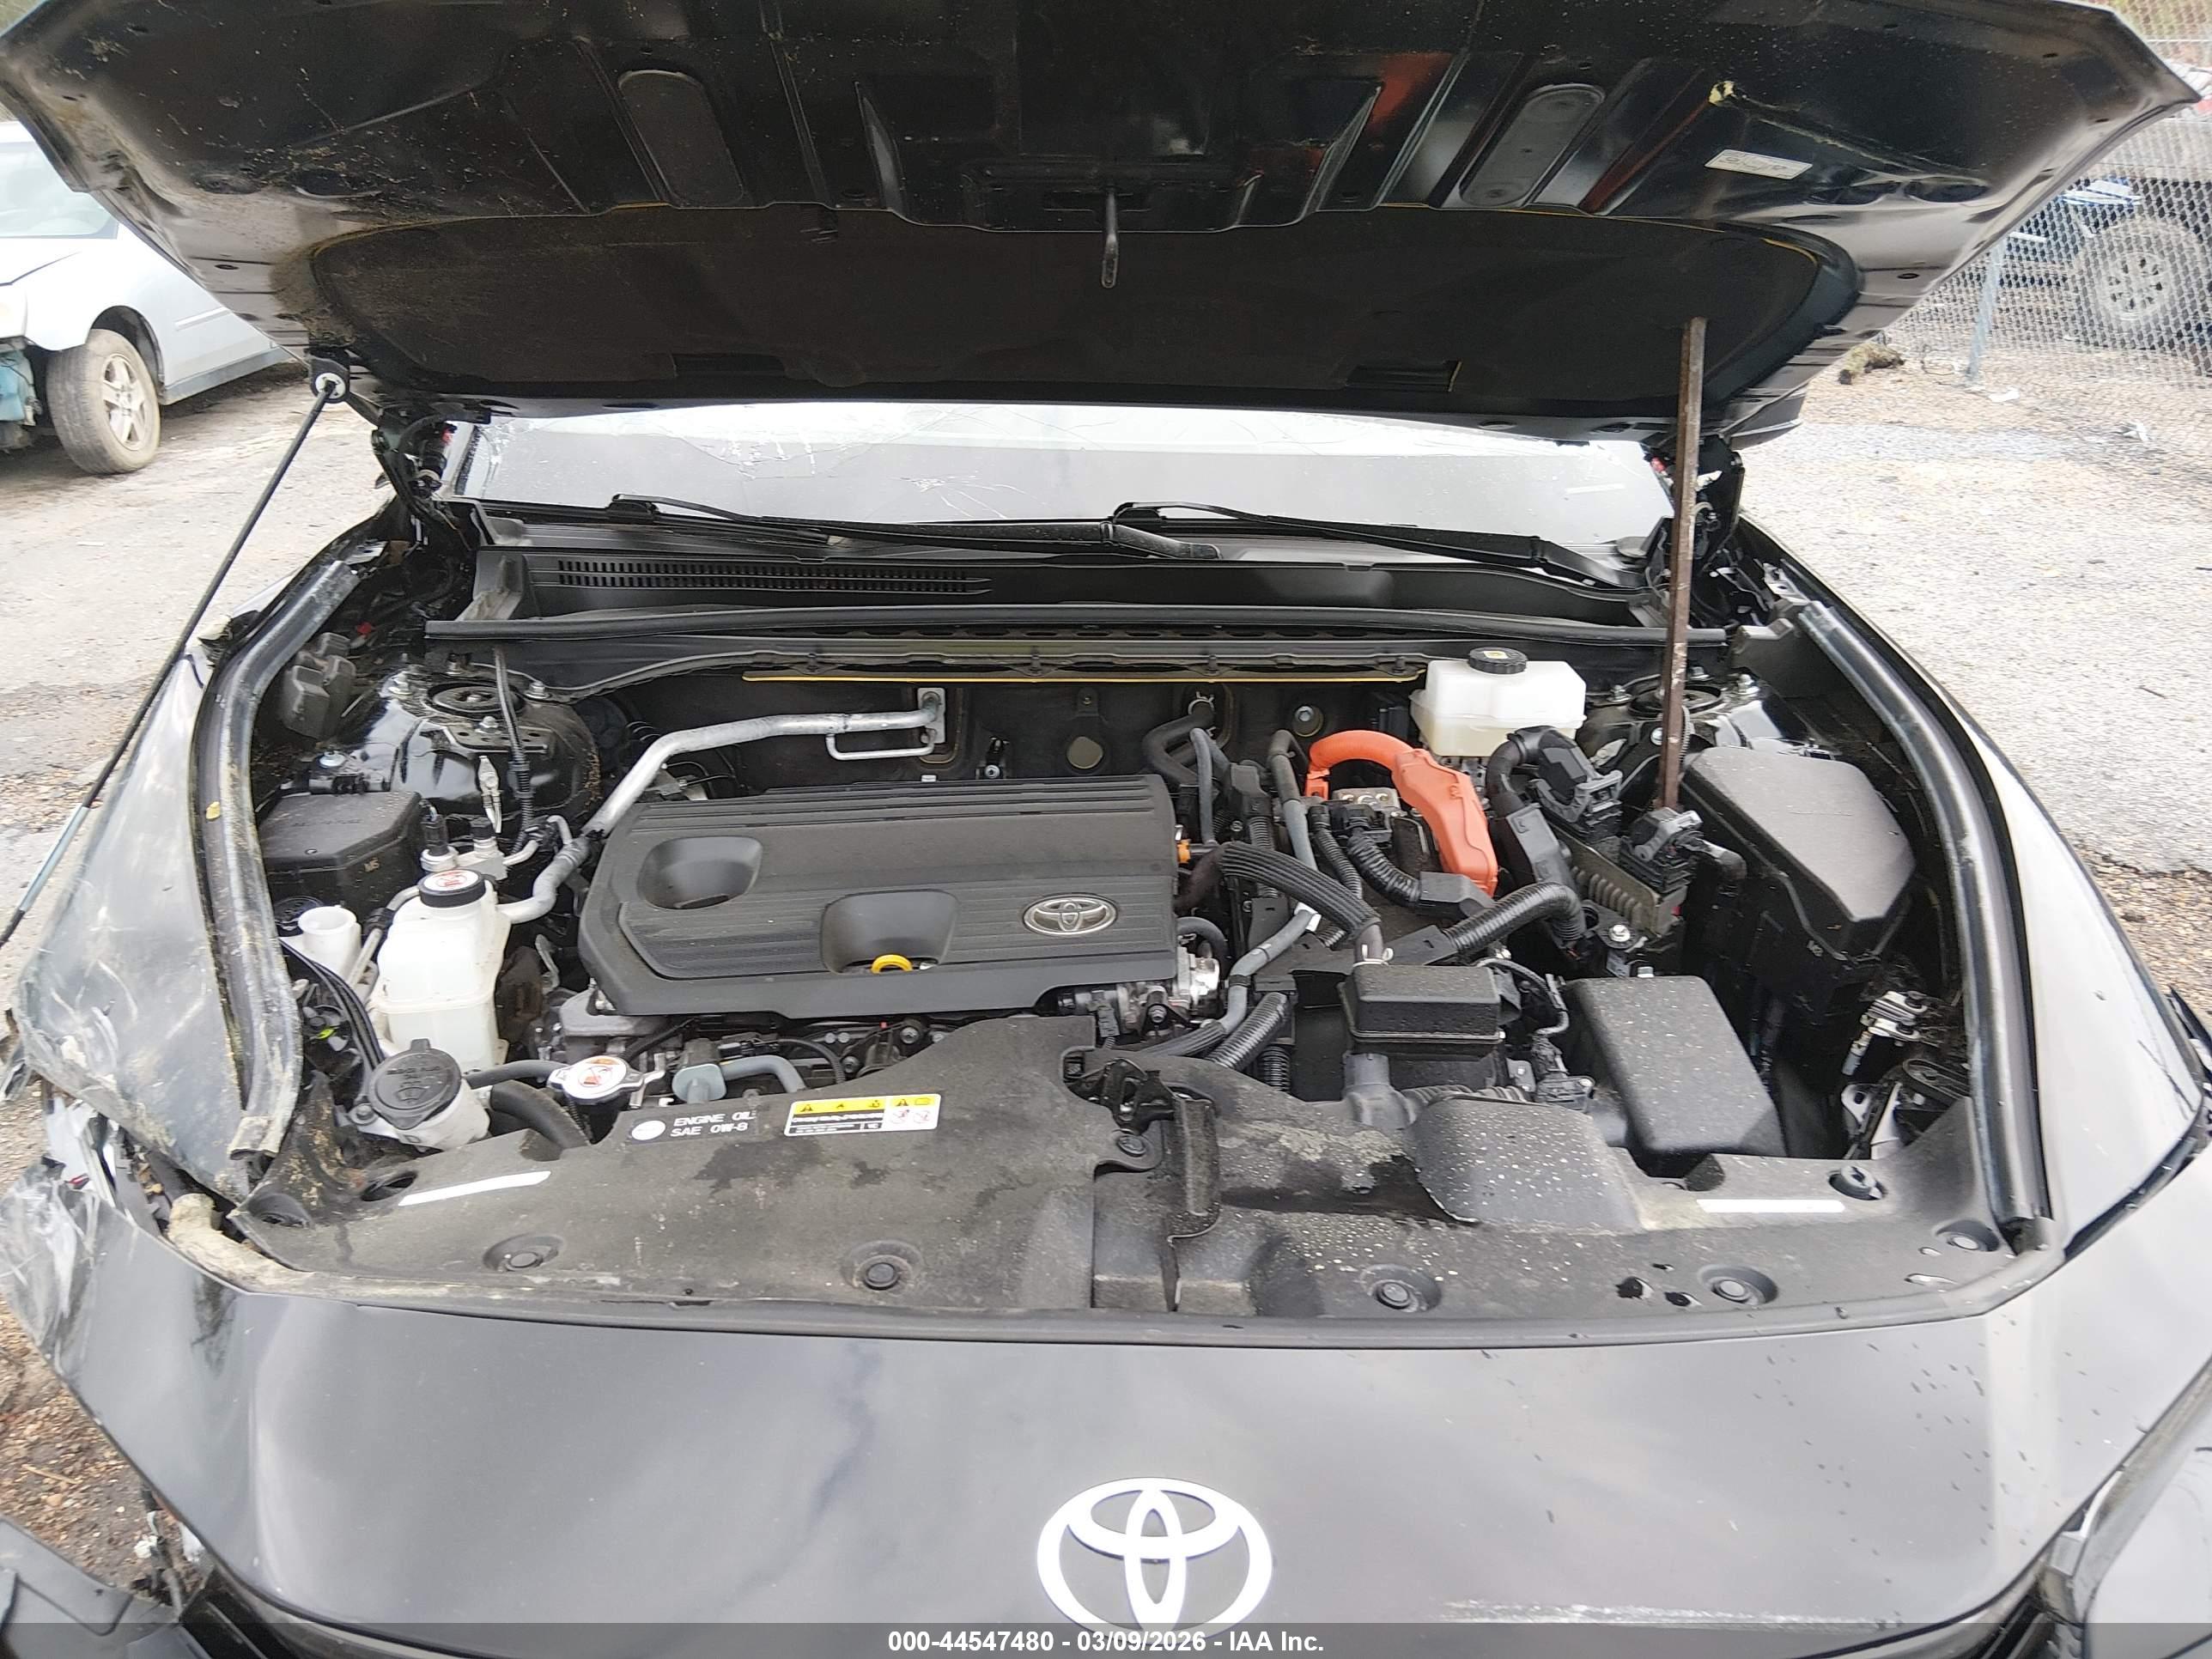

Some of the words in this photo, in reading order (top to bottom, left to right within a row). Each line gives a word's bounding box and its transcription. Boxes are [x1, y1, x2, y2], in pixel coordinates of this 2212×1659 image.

[673, 1113, 726, 1127] ENGINE
[732, 1110, 756, 1121] OIL
[670, 1126, 702, 1138] SAE
[709, 1121, 749, 1133] 0W-8
